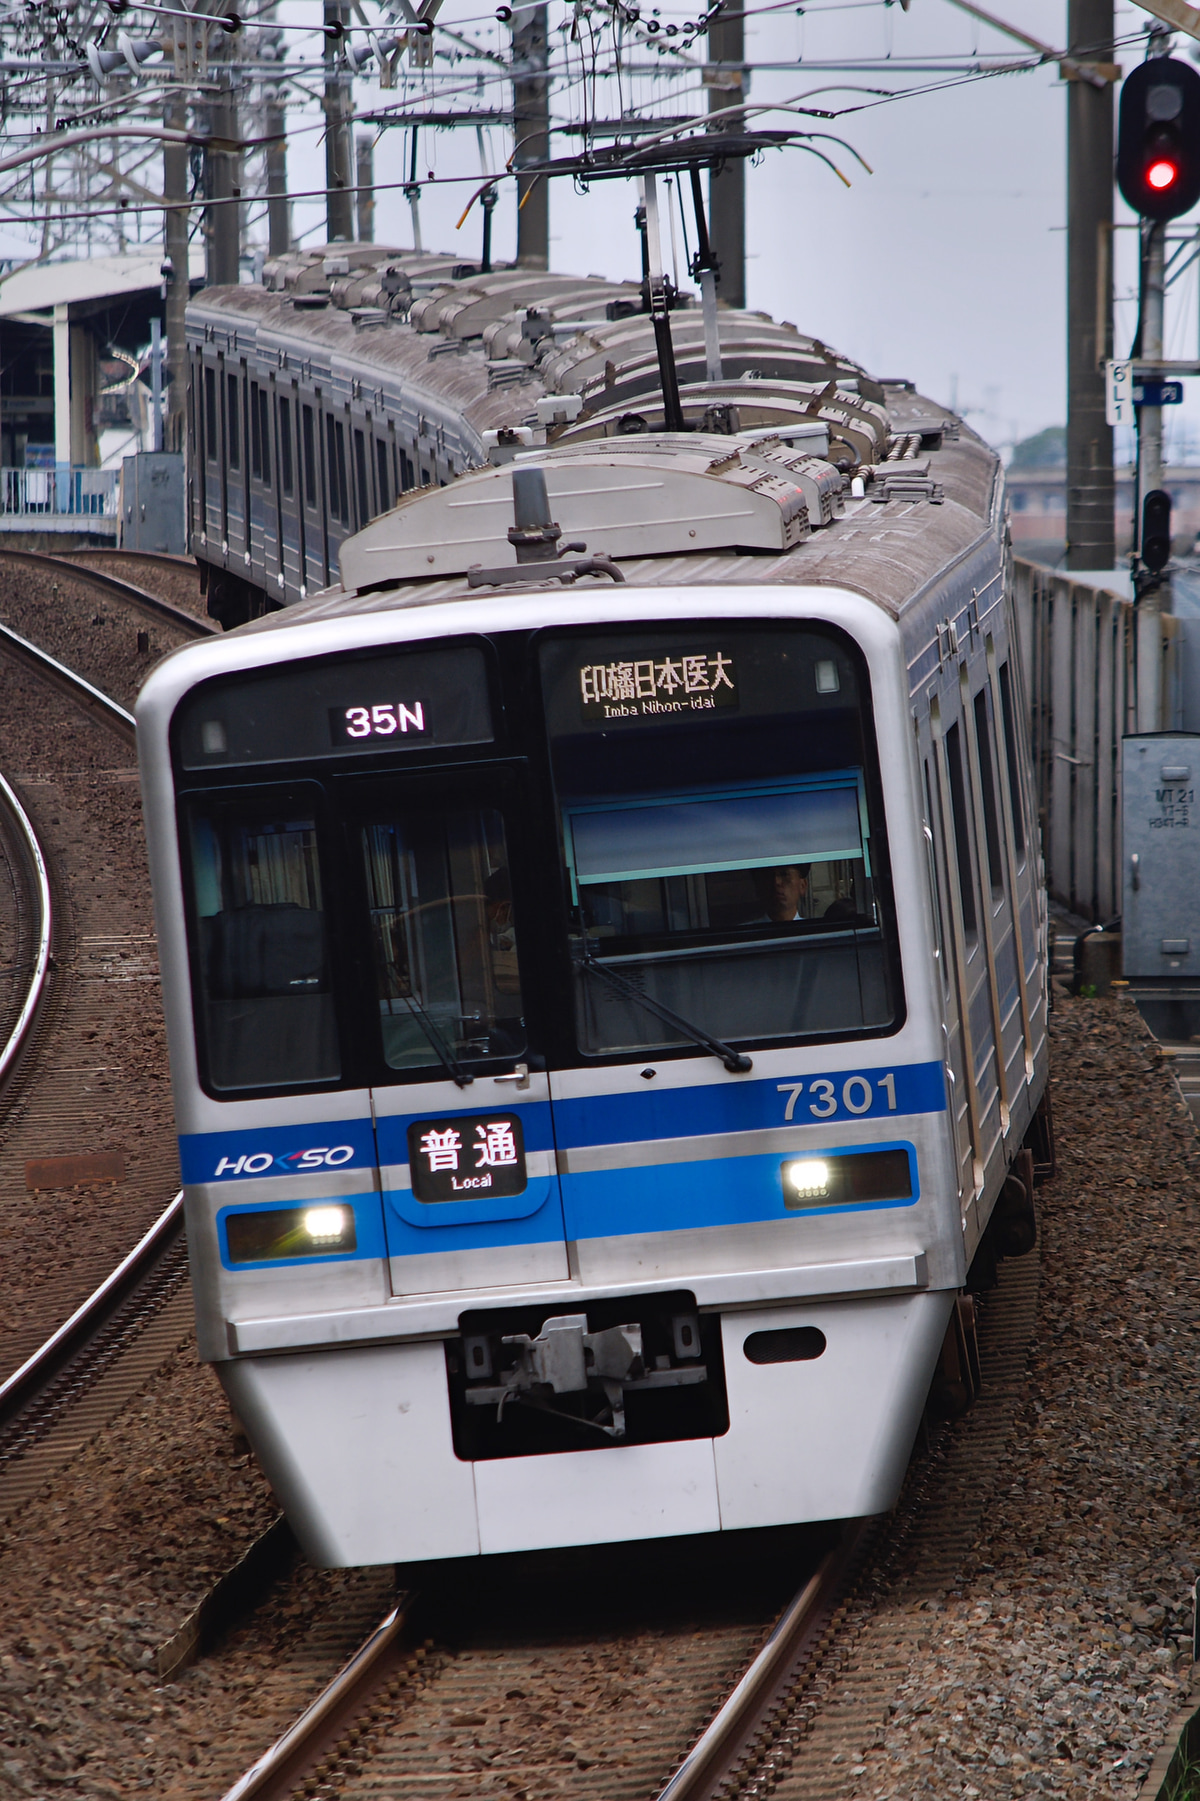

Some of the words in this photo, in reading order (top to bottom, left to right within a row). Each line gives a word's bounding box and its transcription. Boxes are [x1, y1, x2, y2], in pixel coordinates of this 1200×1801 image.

[345, 701, 425, 738] 35N
[604, 702, 639, 718] Imba
[642, 694, 716, 715] Nihon-idai
[776, 1073, 897, 1121] 7301
[420, 1122, 518, 1172] 普通
[451, 1173, 492, 1190] Local
